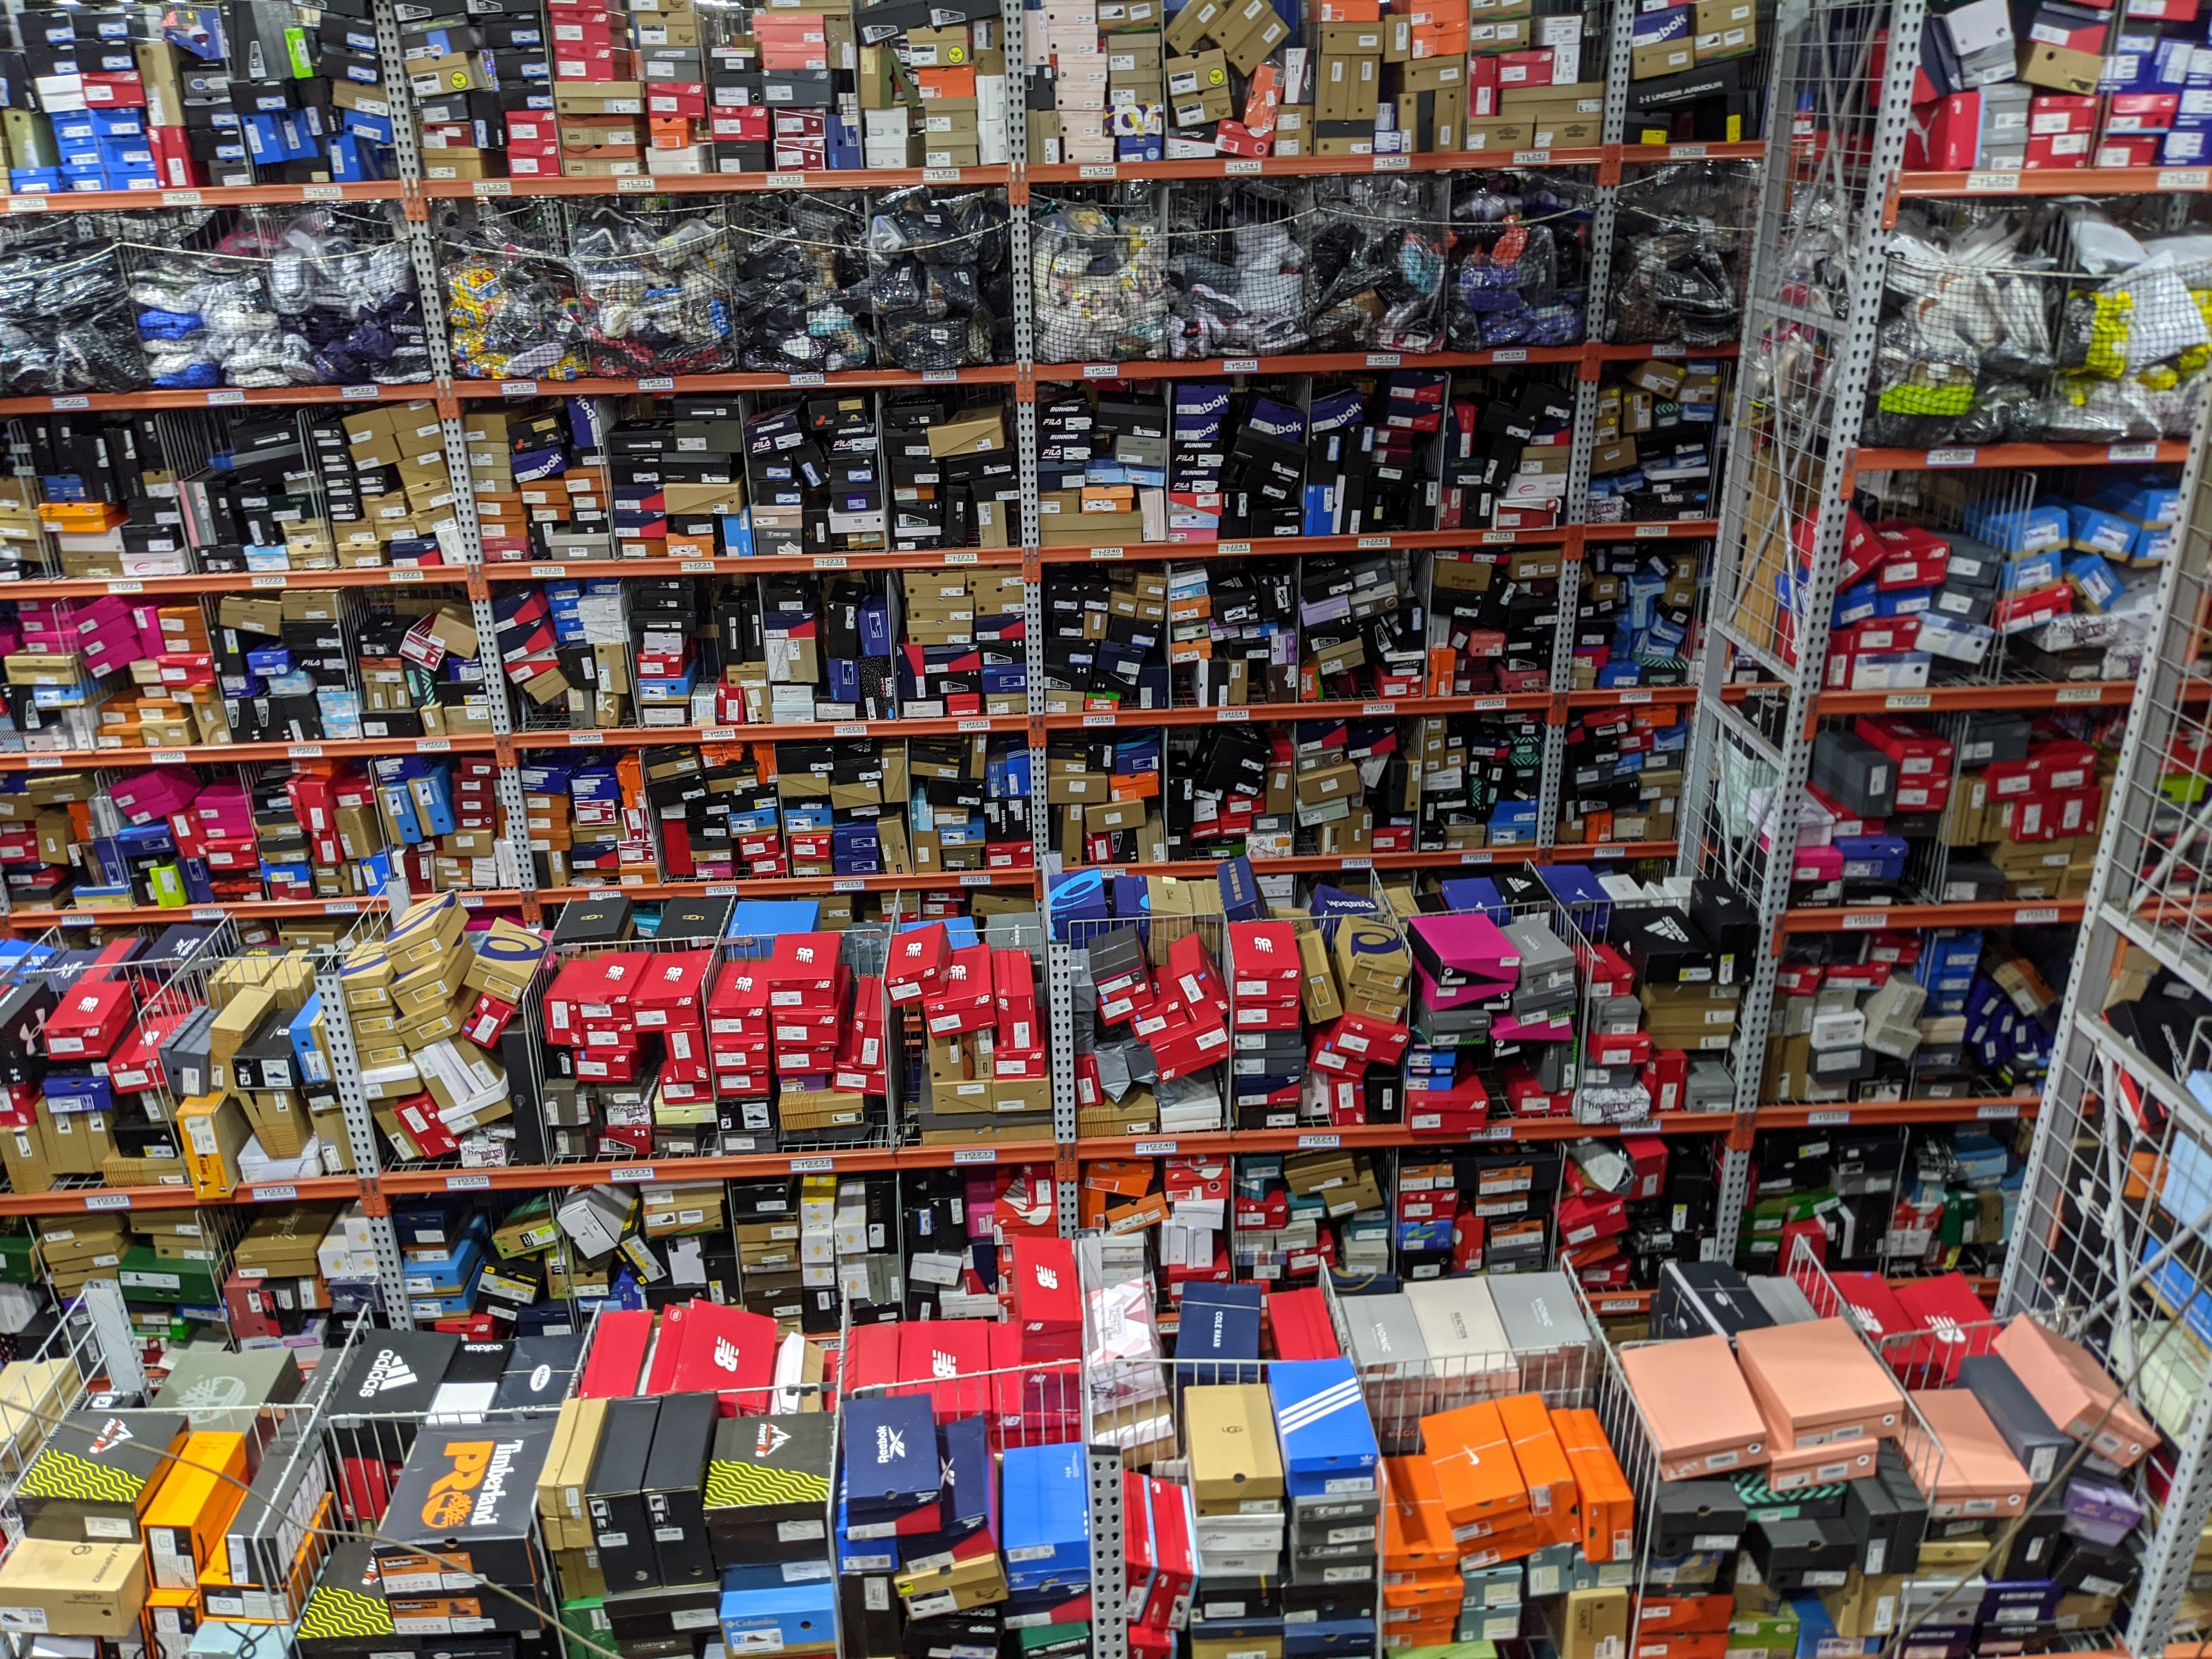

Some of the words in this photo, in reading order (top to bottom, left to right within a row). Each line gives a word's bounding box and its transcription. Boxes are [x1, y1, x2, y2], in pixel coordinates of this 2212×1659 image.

[1651, 89, 1682, 101] UNDER
[1684, 82, 1723, 94] ARMOUR
[757, 422, 783, 433] RUNNING
[753, 439, 770, 450] FILA
[1327, 900, 1375, 909] Reebok
[923, 968, 934, 978] NB
[676, 997, 691, 1006] NB
[975, 995, 989, 1005] NB
[747, 1008, 763, 1017] NB
[819, 1016, 834, 1024] NB
[1214, 1311, 1223, 1328] COLE
[1212, 1329, 1222, 1347] HAAN
[1375, 1322, 1391, 1352] VIONIC
[359, 1349, 394, 1397] adidas
[877, 1425, 889, 1463] Reebok
[471, 1440, 524, 1526] Timberland
[736, 1618, 778, 1627] Columbia
[633, 1640, 675, 1649] FLORSHEIM
[733, 1635, 745, 1644] 12
[1046, 1639, 1079, 1651] MEPHISTO
